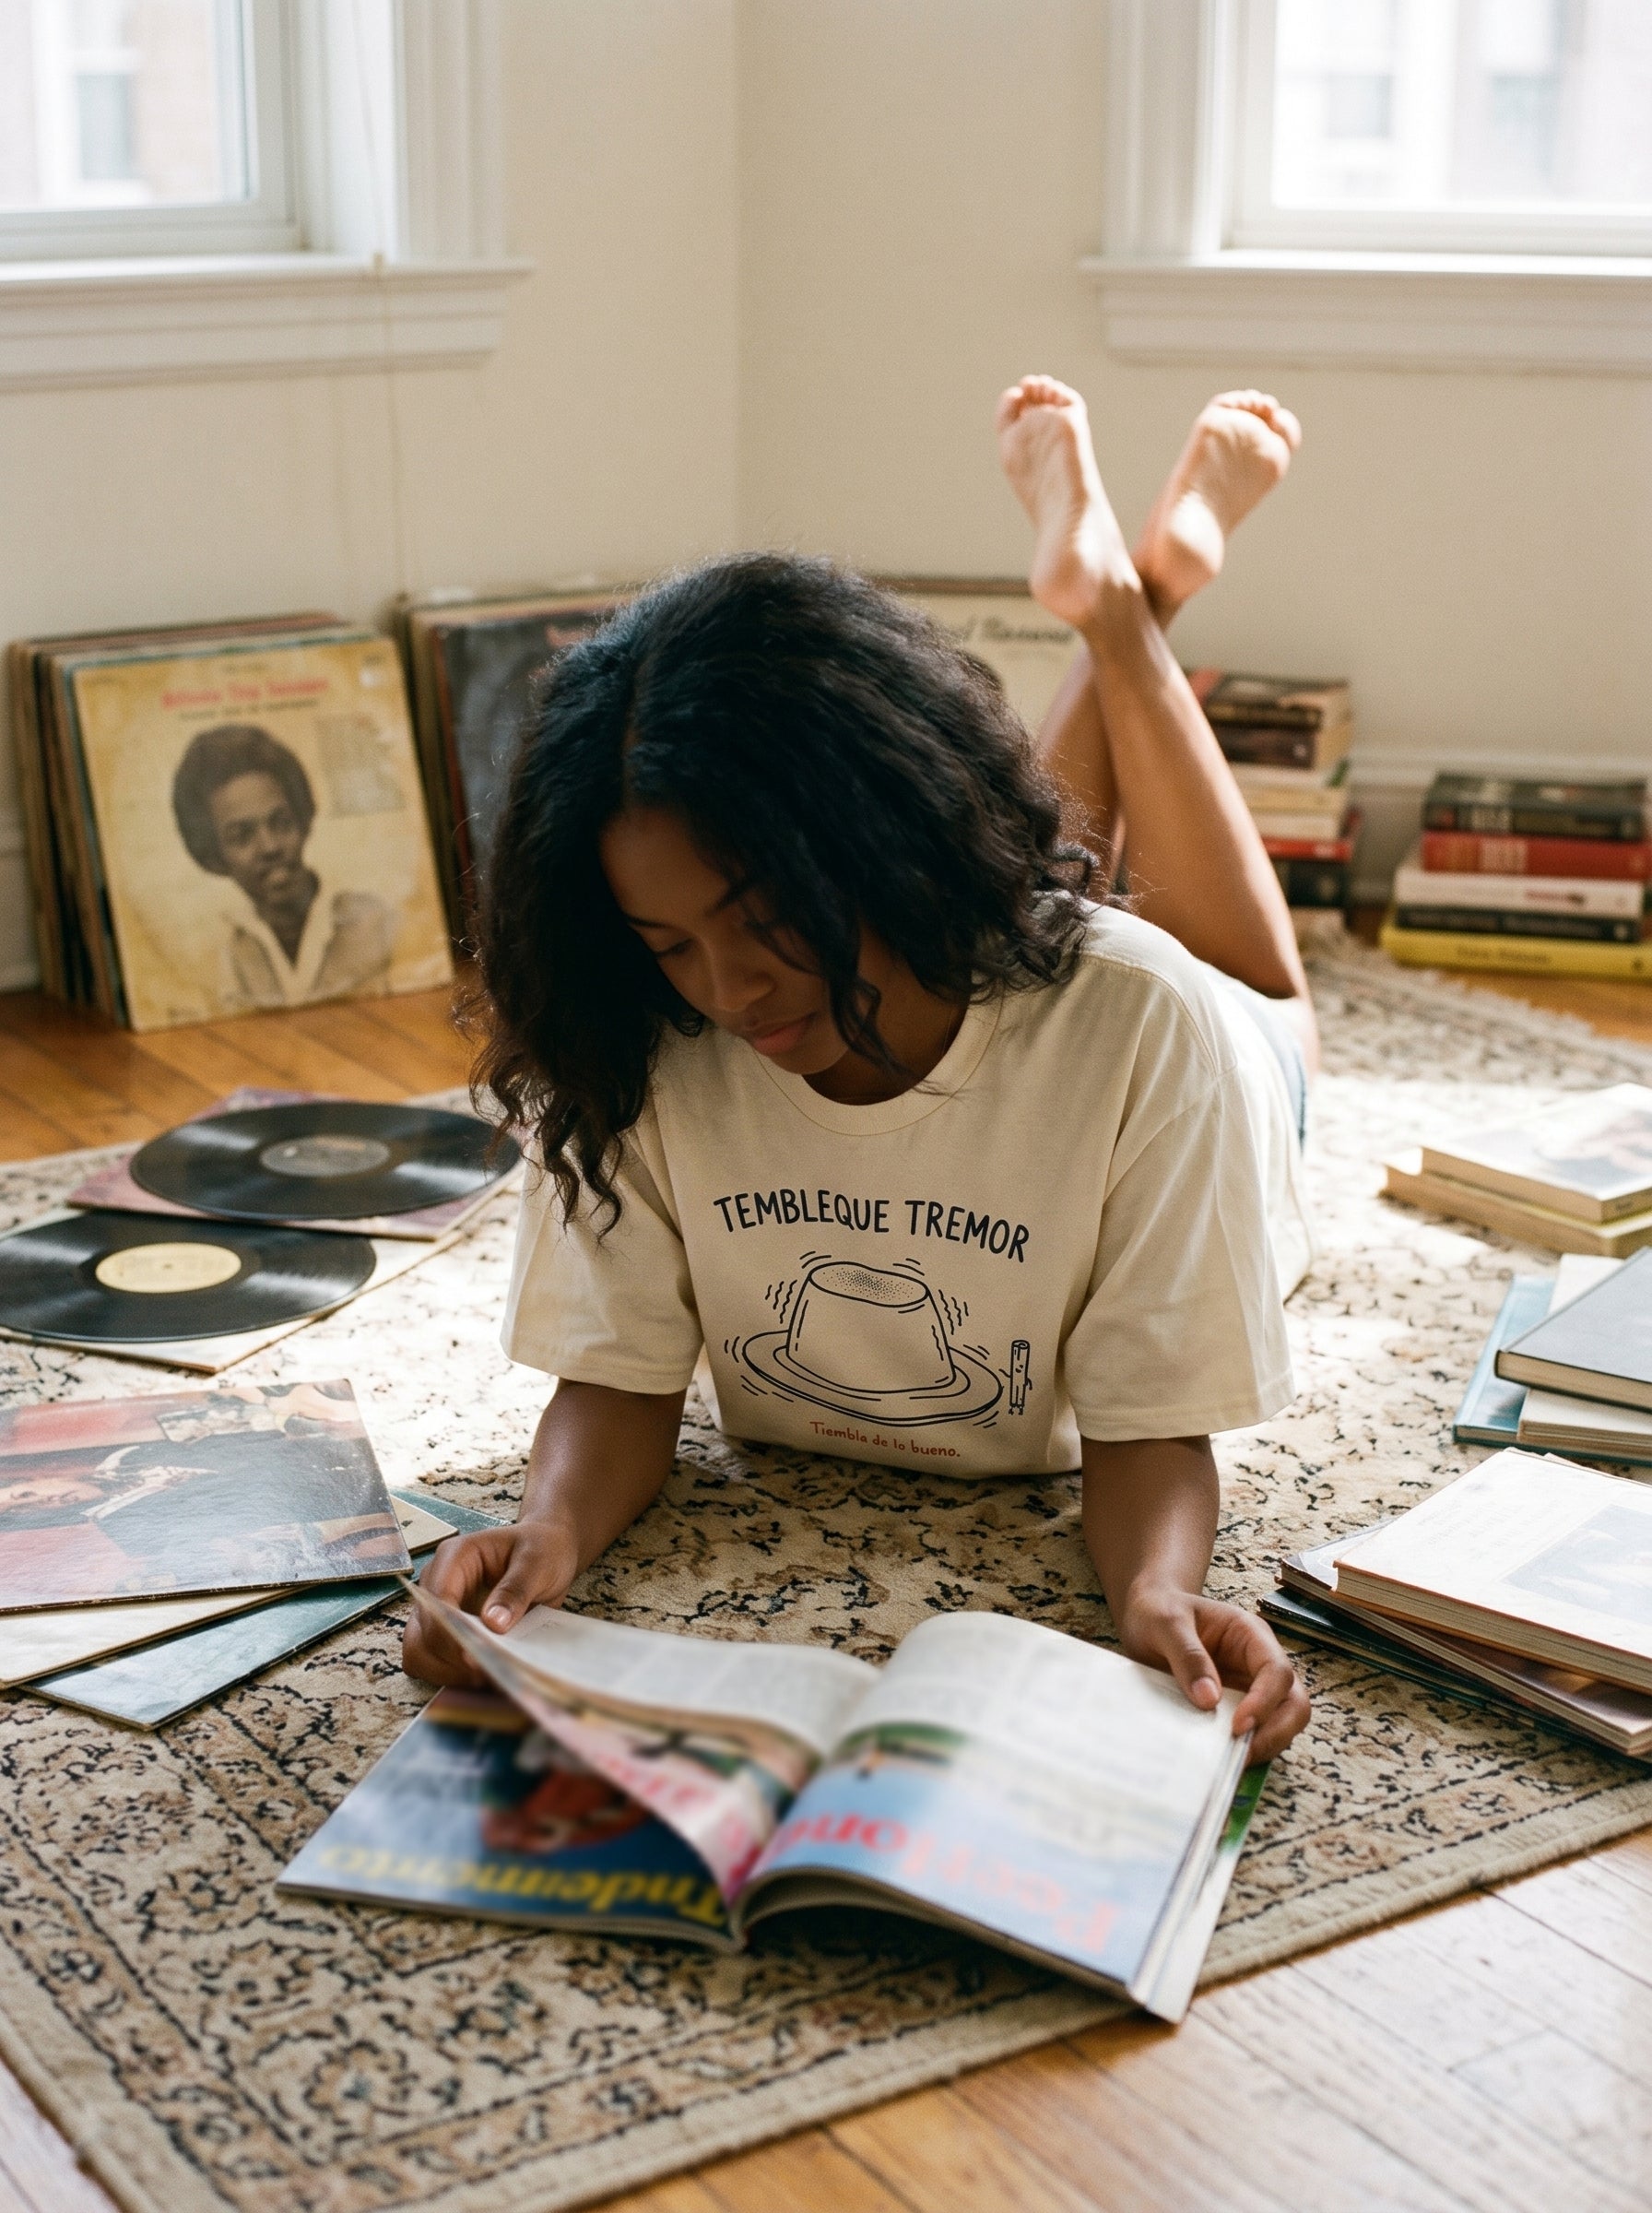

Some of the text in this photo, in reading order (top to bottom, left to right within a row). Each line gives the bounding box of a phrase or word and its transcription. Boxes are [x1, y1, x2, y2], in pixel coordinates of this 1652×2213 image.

[714, 1189, 1030, 1263] TEMBLEQUE TREMOR
[809, 1421, 962, 1458] Tiembla de lo bueno.
